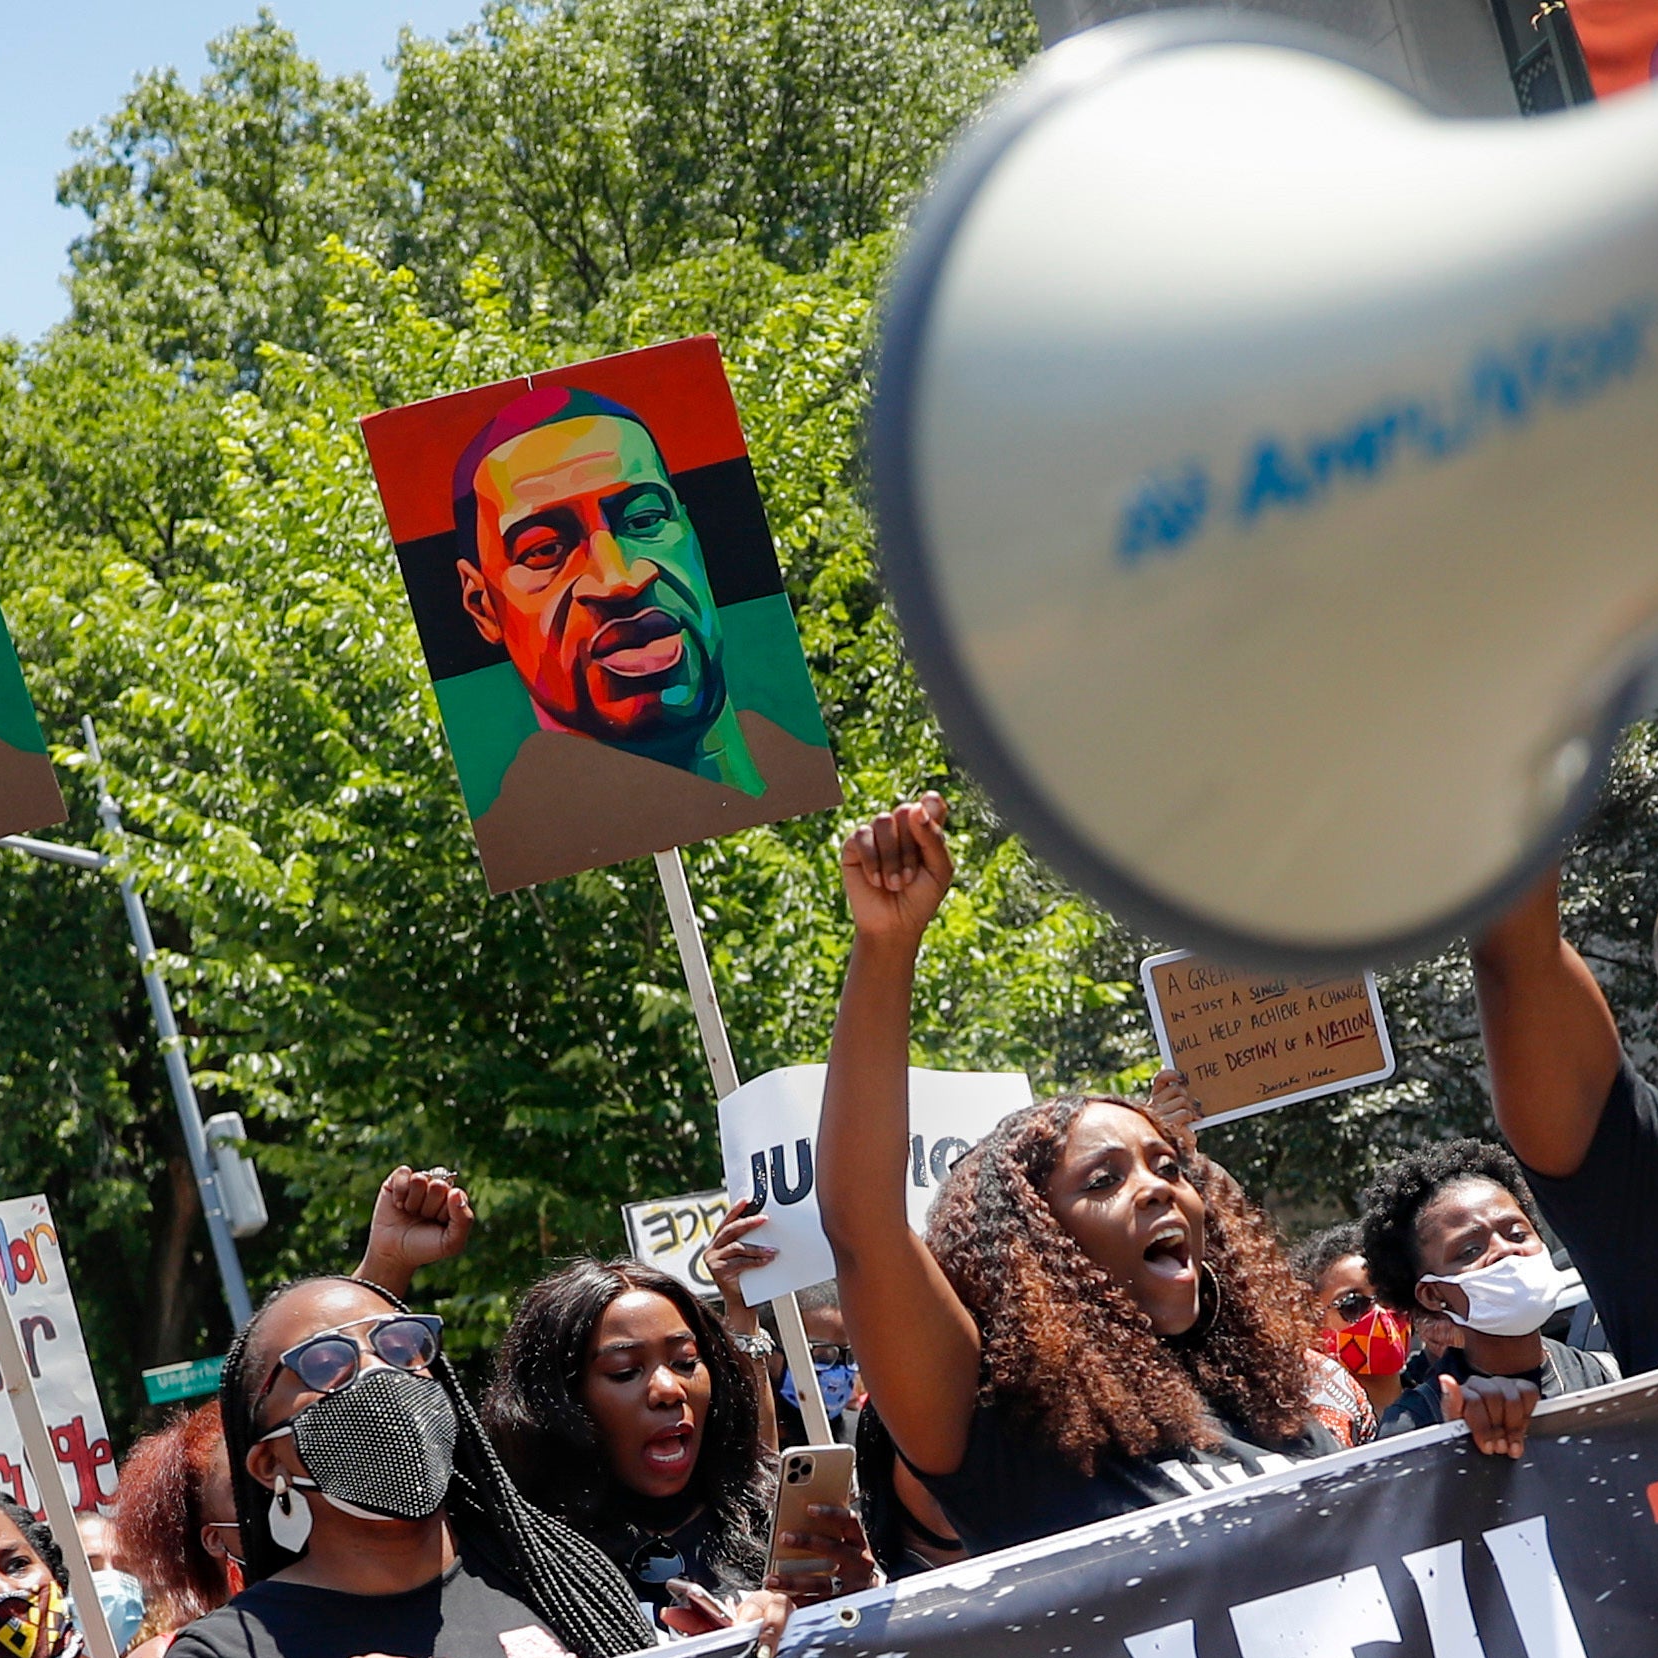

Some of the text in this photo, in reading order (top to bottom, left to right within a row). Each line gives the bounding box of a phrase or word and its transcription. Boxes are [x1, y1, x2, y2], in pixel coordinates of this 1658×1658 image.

[1172, 1010, 1185, 1022] IN
[1191, 998, 1224, 1016] JUST
[1232, 991, 1242, 1005] A
[1249, 979, 1289, 1001] SINGLE
[1172, 983, 1366, 1054] WILL HELP ACHIEVE A CHANGE
[1195, 1060, 1221, 1081] THE
[1225, 1037, 1278, 1072] DESTINY
[1285, 1038, 1297, 1051] OF
[1305, 1032, 1314, 1046] A
